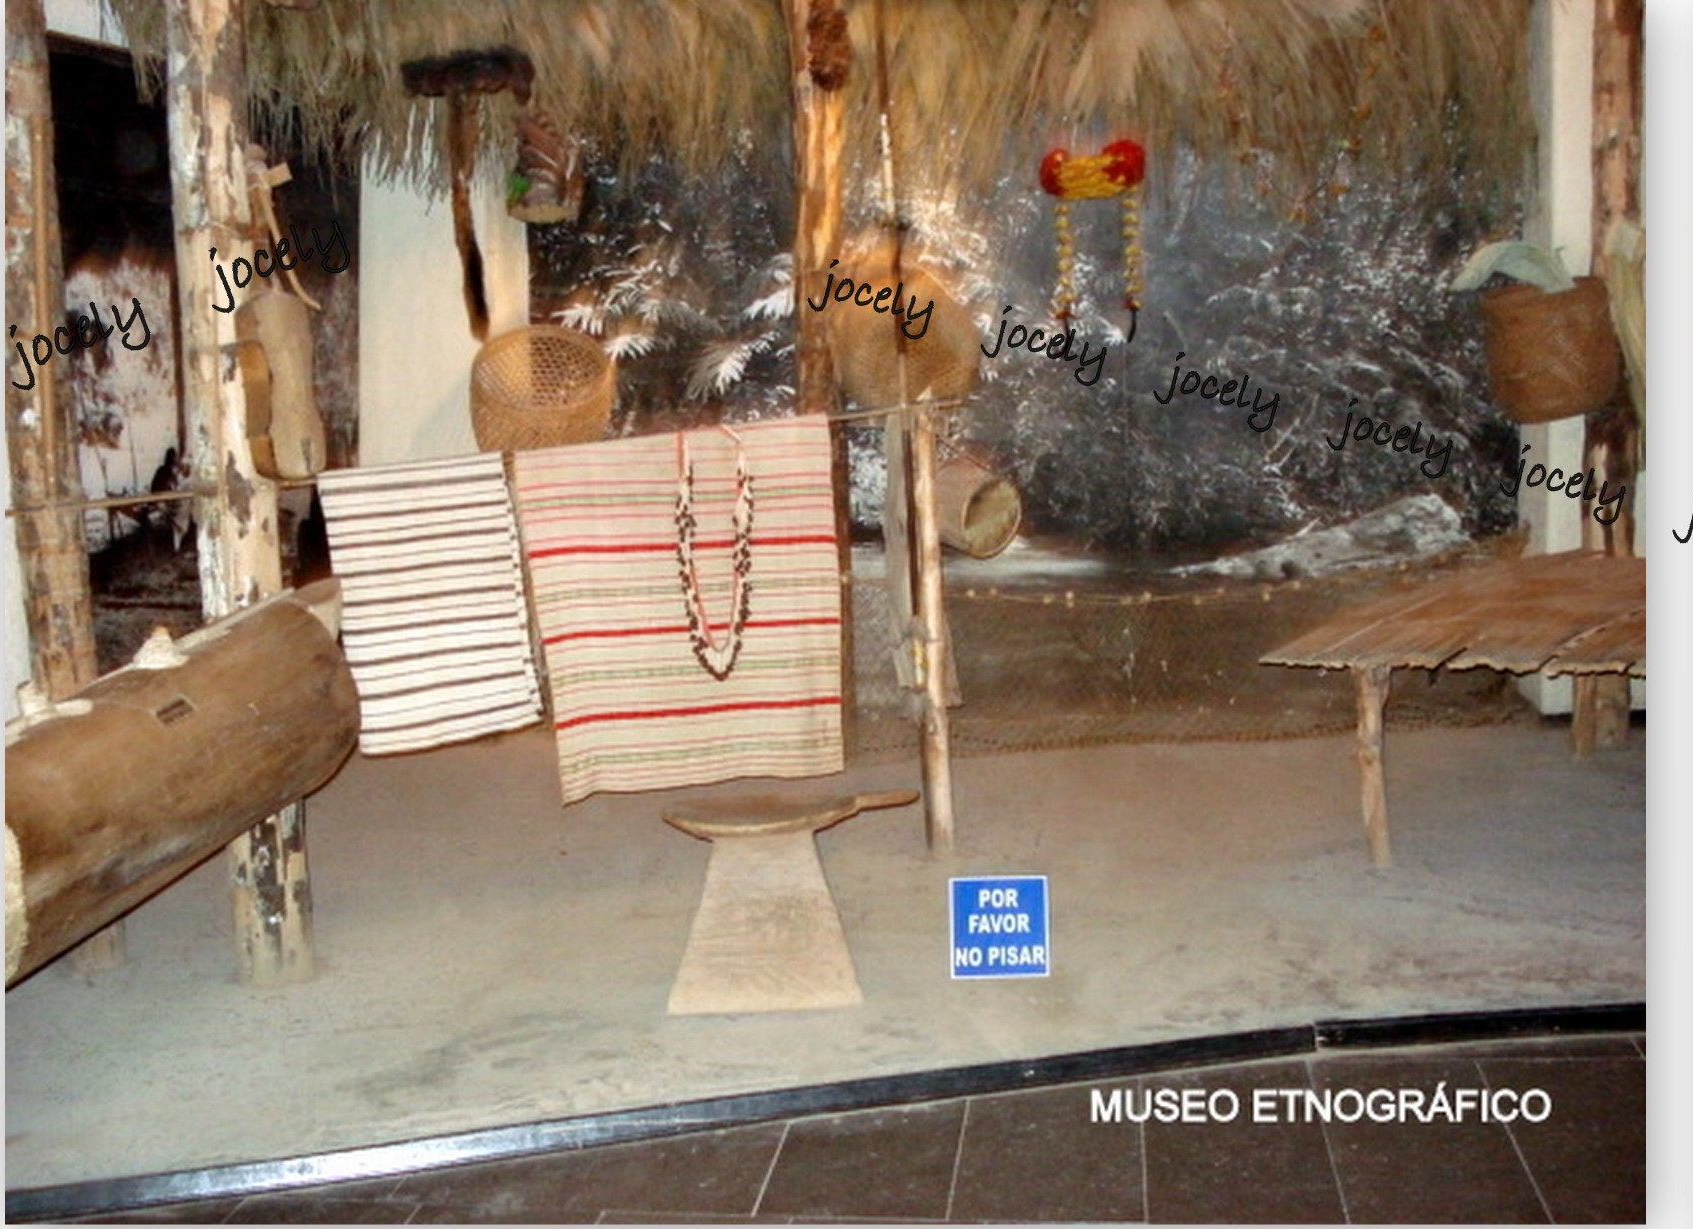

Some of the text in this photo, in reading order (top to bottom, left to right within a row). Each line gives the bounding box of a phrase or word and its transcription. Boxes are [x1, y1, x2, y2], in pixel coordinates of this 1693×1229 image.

[979, 888, 1018, 908] POR
[968, 913, 1030, 934] FAVOR
[955, 945, 1045, 967] NO PISAR
